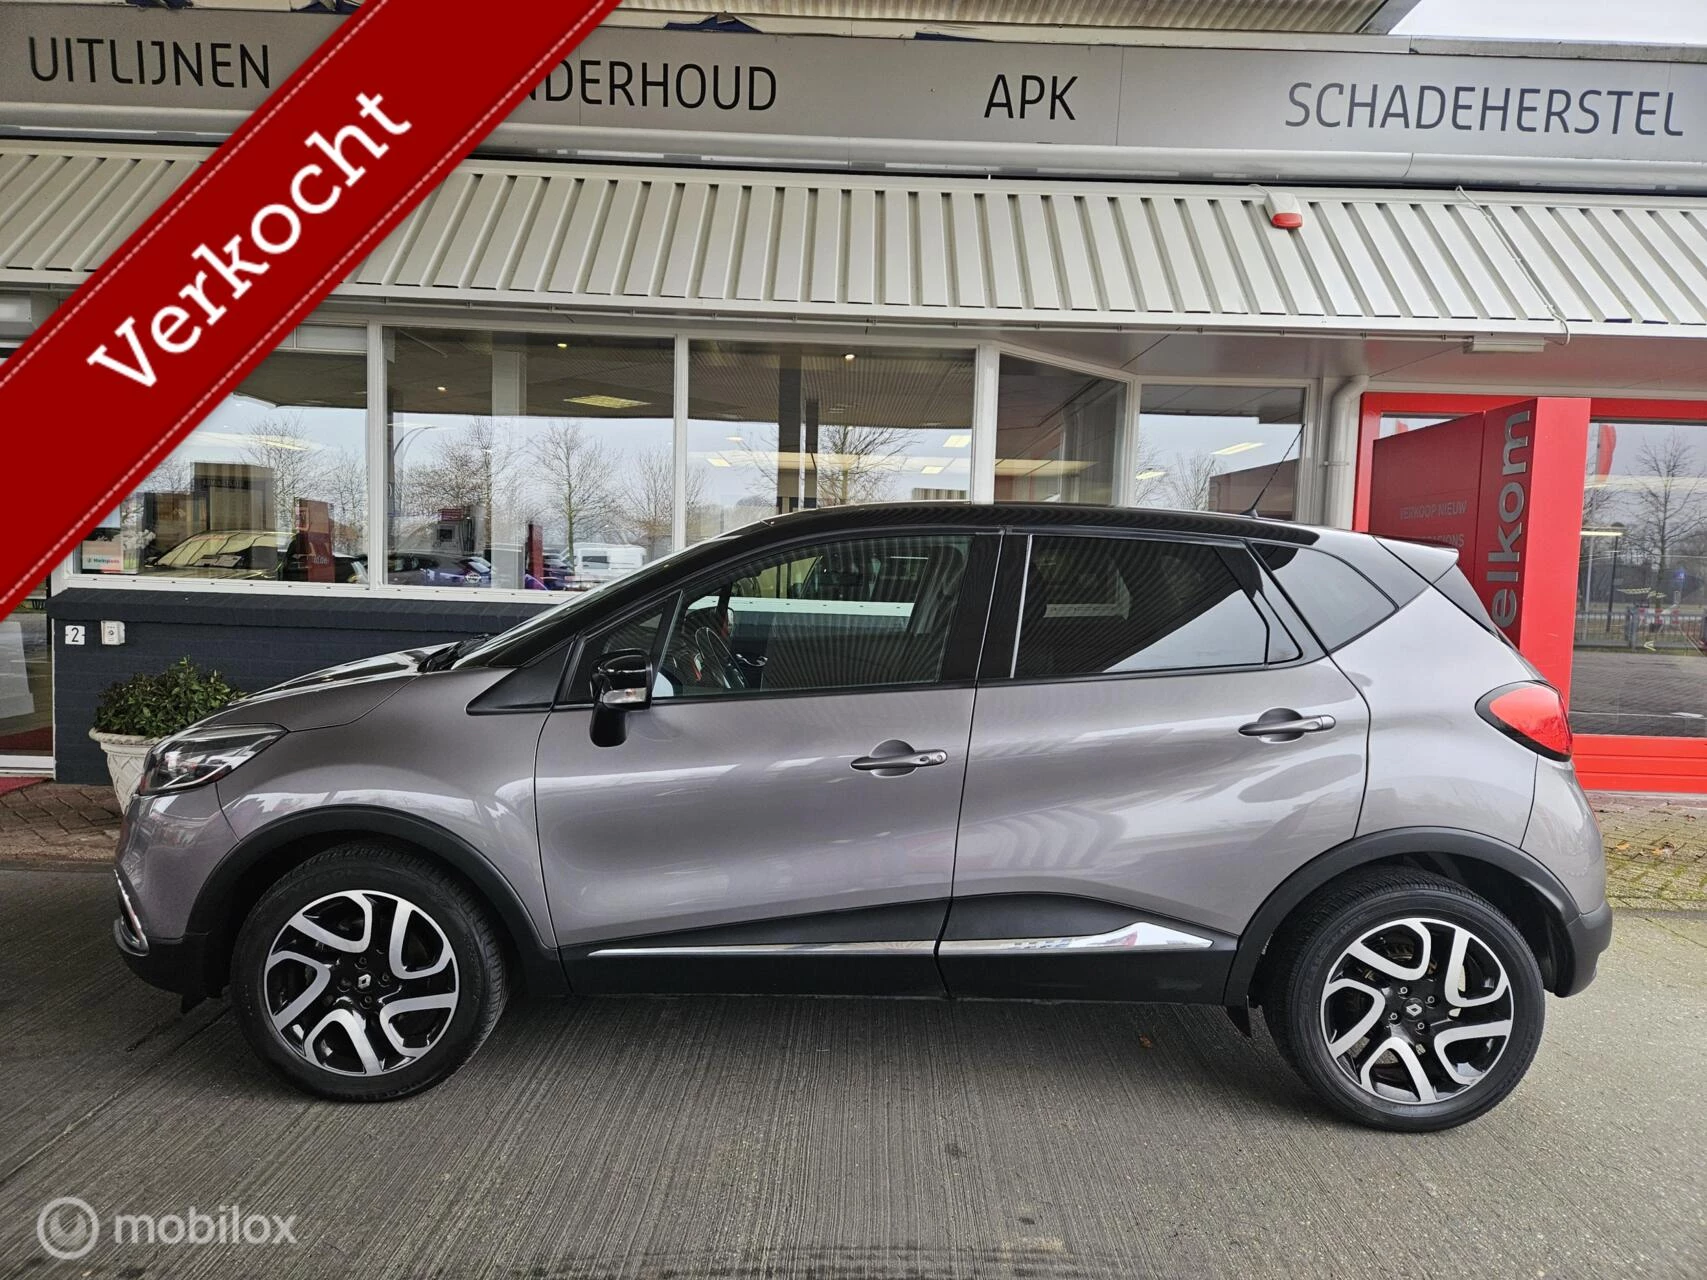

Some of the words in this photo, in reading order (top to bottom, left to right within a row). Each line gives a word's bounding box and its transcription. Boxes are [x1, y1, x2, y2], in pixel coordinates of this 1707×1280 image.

[27, 35, 271, 89] UITLIJNEN
[527, 57, 778, 112] DERHOUD
[983, 73, 1080, 121] APK
[1284, 81, 1685, 137] SCHADEHERSTEL
[70, 626, 80, 644] 2
